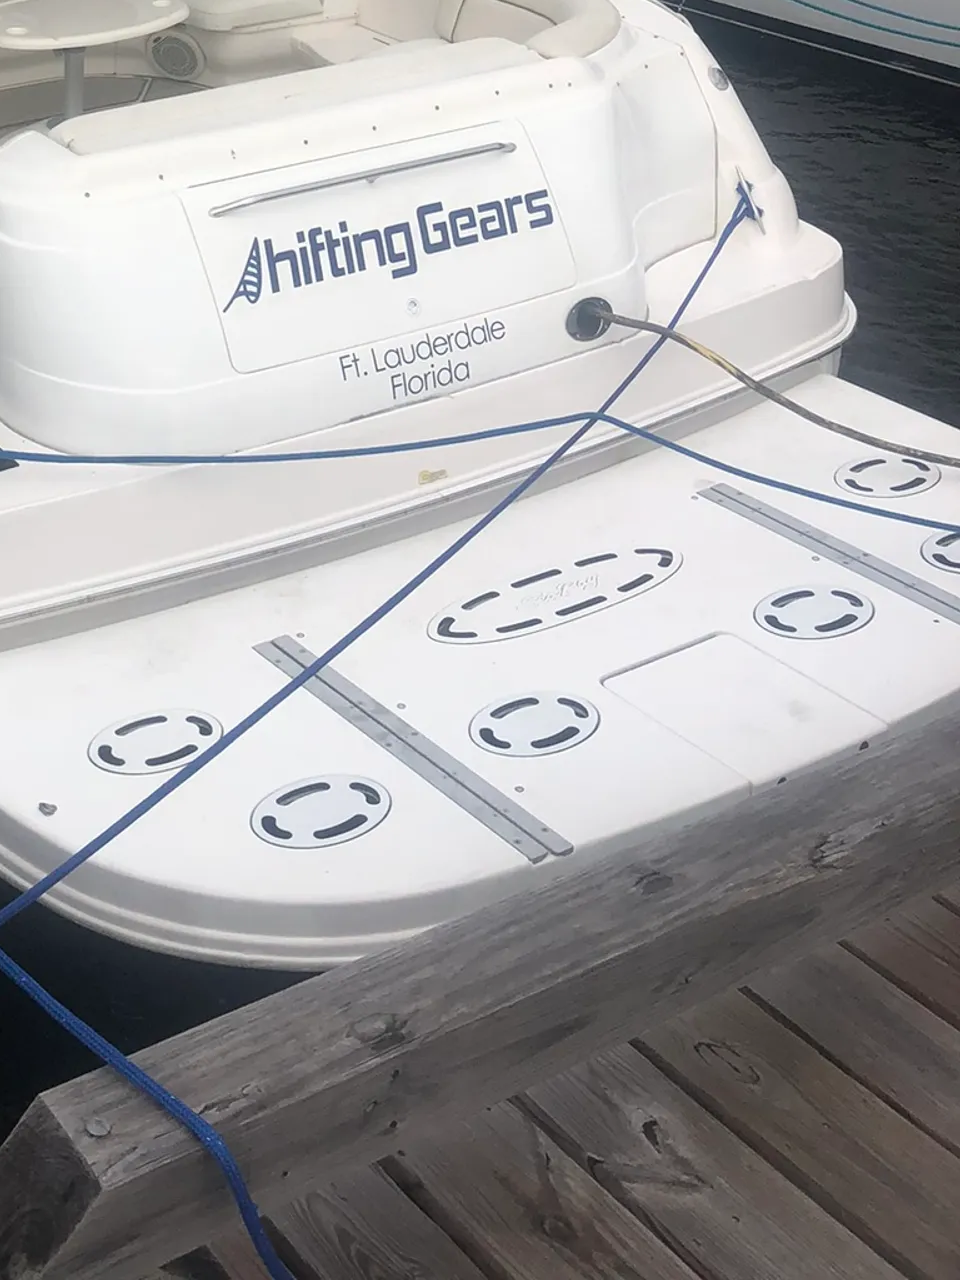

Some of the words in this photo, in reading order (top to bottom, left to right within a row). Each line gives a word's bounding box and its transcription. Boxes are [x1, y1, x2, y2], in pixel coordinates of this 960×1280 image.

[417, 189, 554, 255] Gears
[339, 351, 369, 381] Ft.
[371, 317, 506, 373] Lauderdale
[390, 360, 470, 400] Florida
